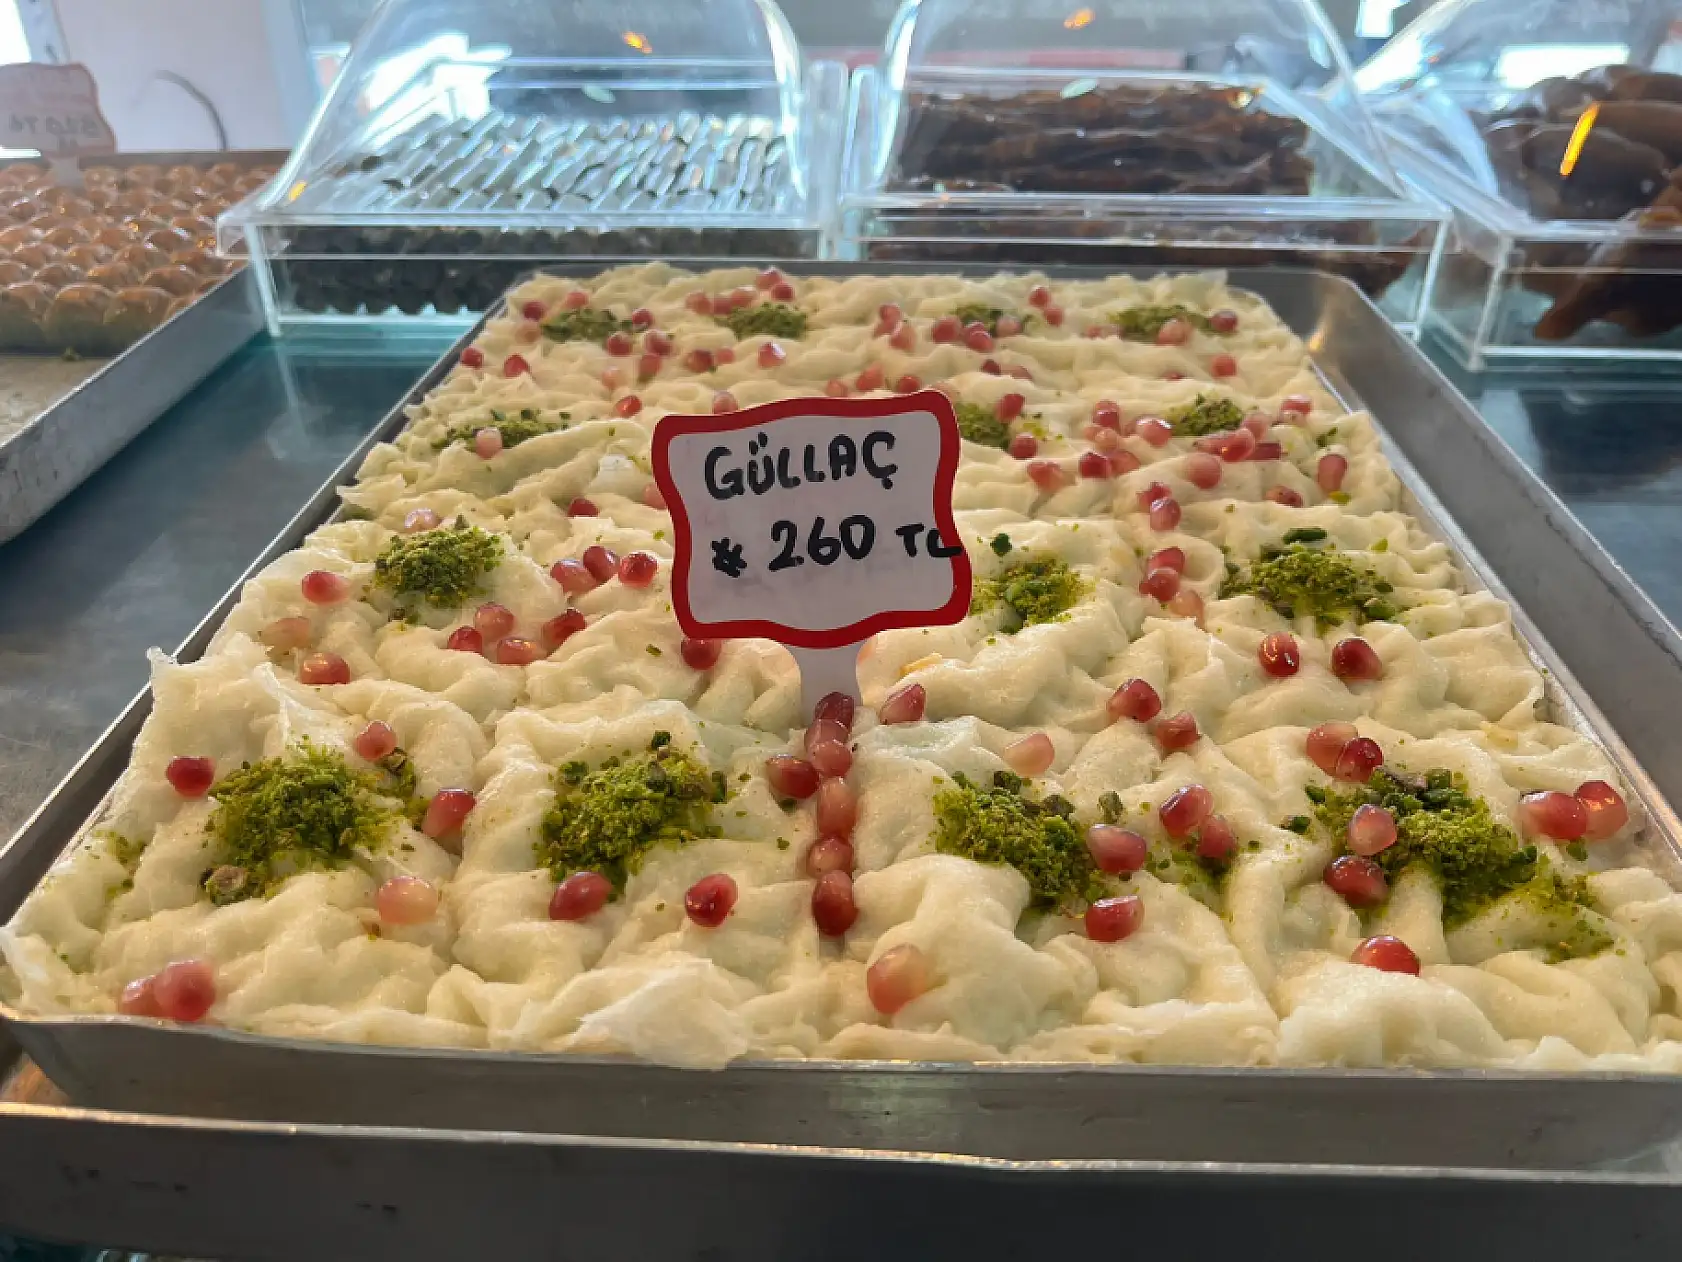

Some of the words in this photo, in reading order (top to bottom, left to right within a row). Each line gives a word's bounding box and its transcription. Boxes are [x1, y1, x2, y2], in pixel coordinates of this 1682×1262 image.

[704, 431, 898, 500] GÜLLAÇ
[768, 514, 875, 572] 260
[895, 523, 963, 558] TL
